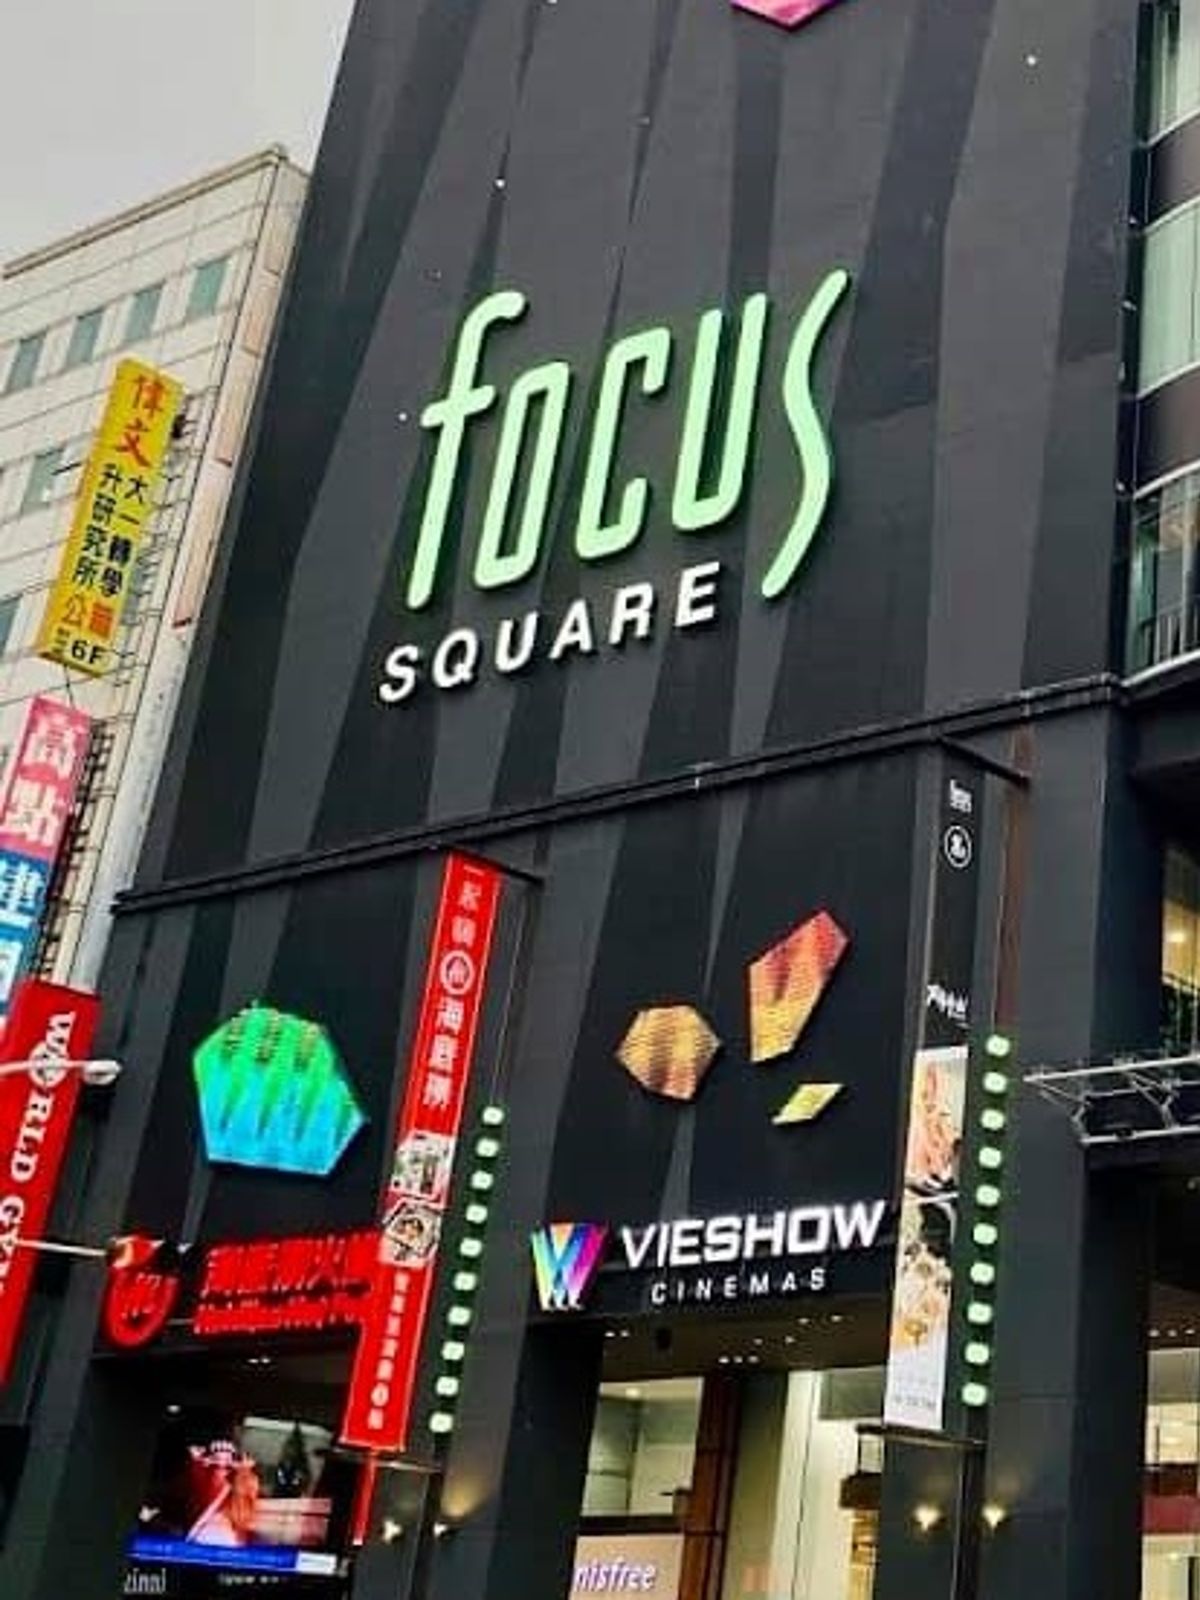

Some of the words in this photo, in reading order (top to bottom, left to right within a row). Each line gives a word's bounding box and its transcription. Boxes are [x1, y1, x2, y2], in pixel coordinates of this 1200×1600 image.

[379, 561, 721, 703] SQUARE
[10, 1011, 76, 1183] WORLD
[622, 1200, 886, 1268] VIESHOW
[652, 1268, 826, 1304] CINEMAS
